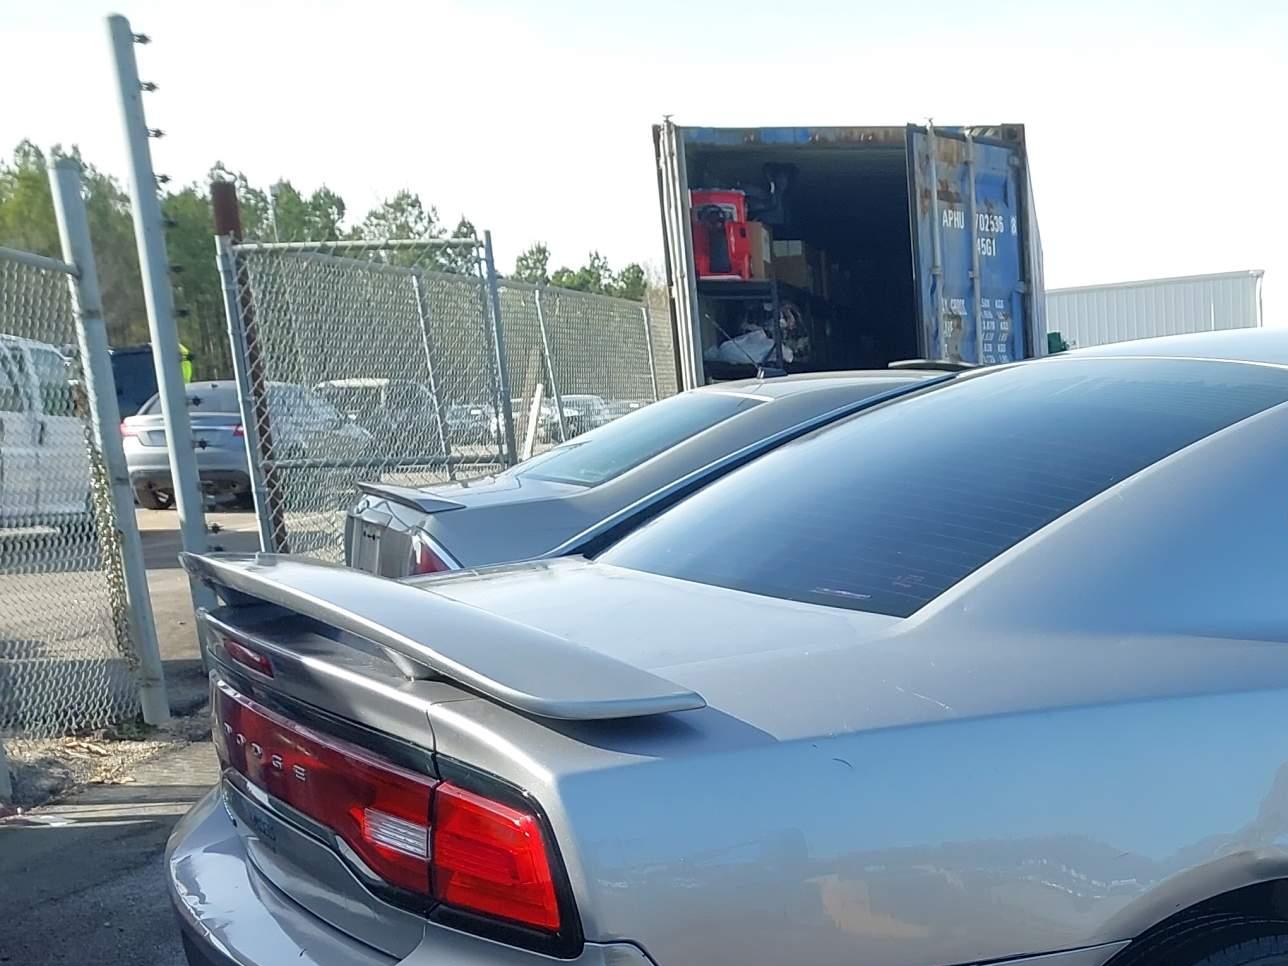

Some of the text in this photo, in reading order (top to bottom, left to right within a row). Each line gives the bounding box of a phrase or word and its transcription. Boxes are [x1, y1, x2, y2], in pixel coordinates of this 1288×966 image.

[942, 209, 966, 230] APHU
[1011, 216, 1018, 236] 8
[223, 722, 308, 783] DODGE
